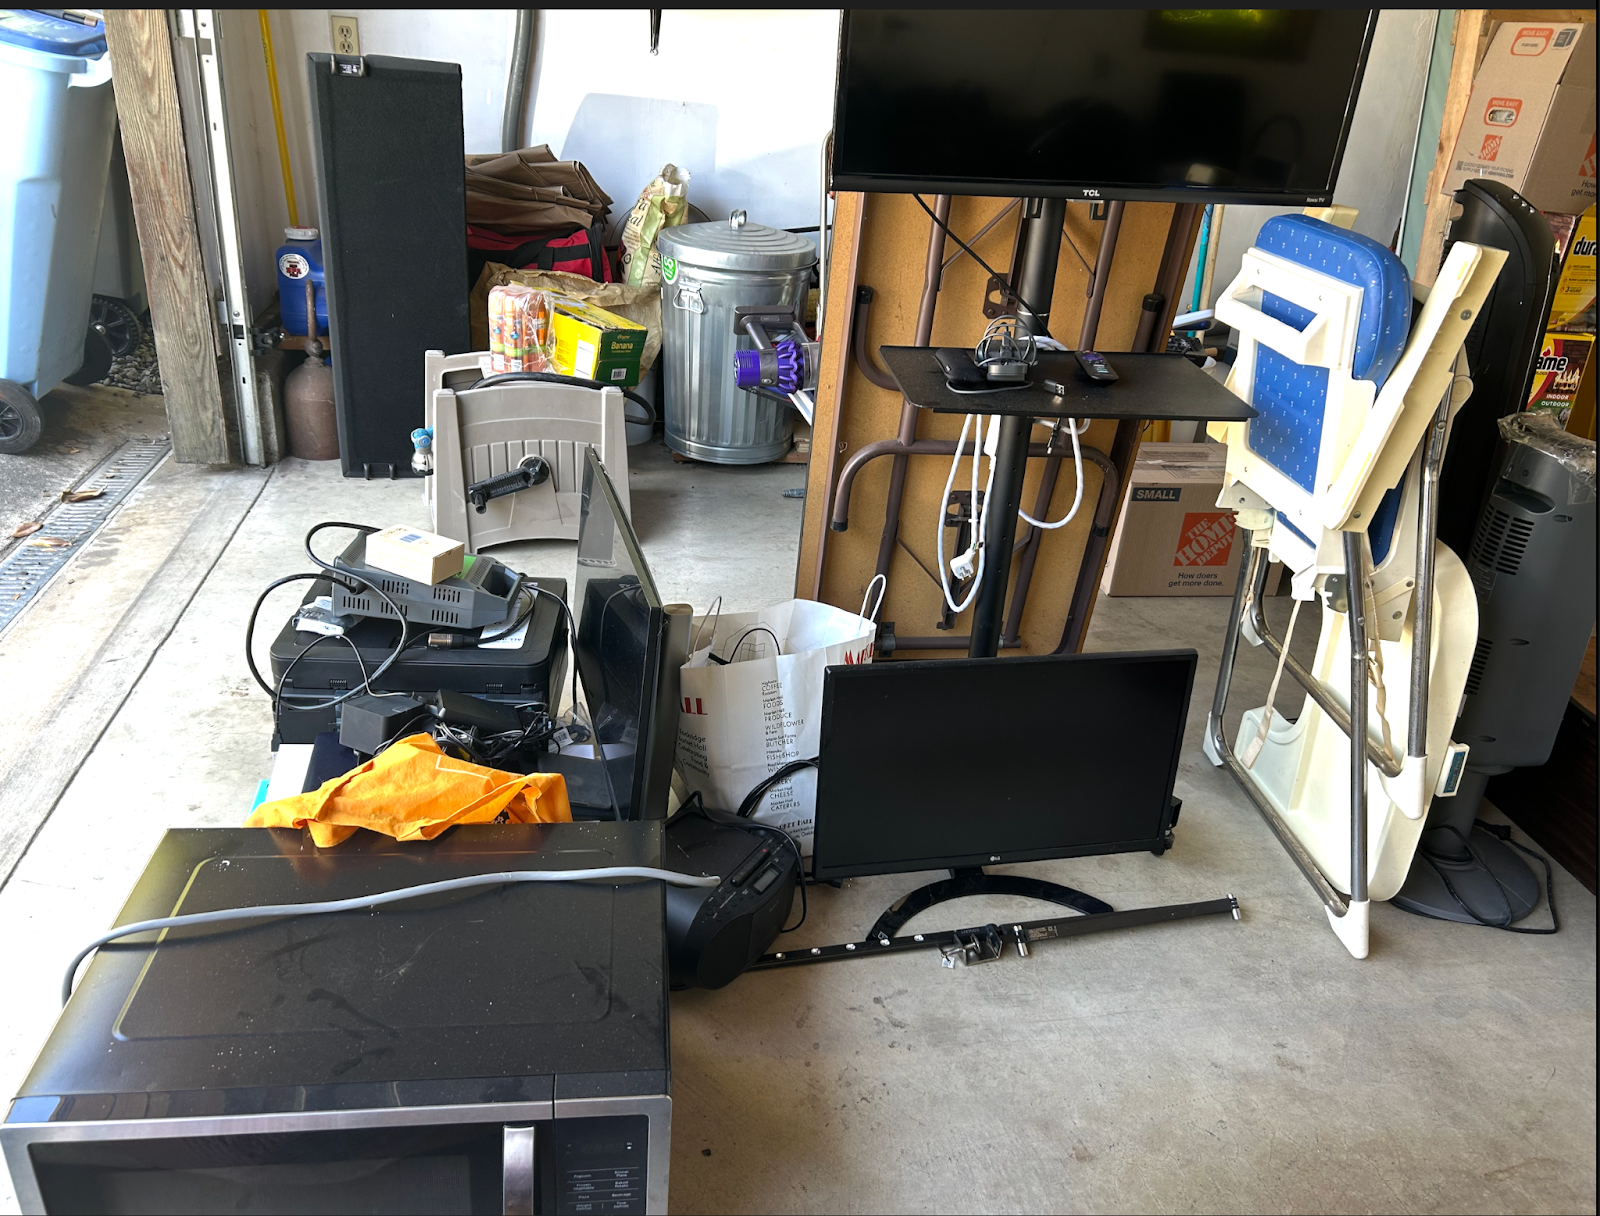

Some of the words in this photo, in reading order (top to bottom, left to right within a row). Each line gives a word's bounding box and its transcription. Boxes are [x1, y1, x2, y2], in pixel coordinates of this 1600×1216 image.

[1479, 135, 1501, 159] HOME
[611, 341, 634, 350] Banana
[1136, 489, 1176, 500] SMALL
[1185, 518, 1211, 540] THE
[1175, 512, 1236, 566] HOME
[1195, 532, 1233, 566] DEPOT
[761, 682, 783, 692] COFFEE
[763, 700, 784, 709] FOODS
[764, 712, 792, 722] PRODUCE
[764, 719, 804, 731] WILDFLOWER
[693, 742, 707, 751] Hall
[766, 739, 794, 748] BUTCHER
[766, 753, 781, 761] FISH
[782, 750, 800, 759] SHOP
[770, 790, 793, 799] CHEESE
[771, 801, 801, 811] CATERERS
